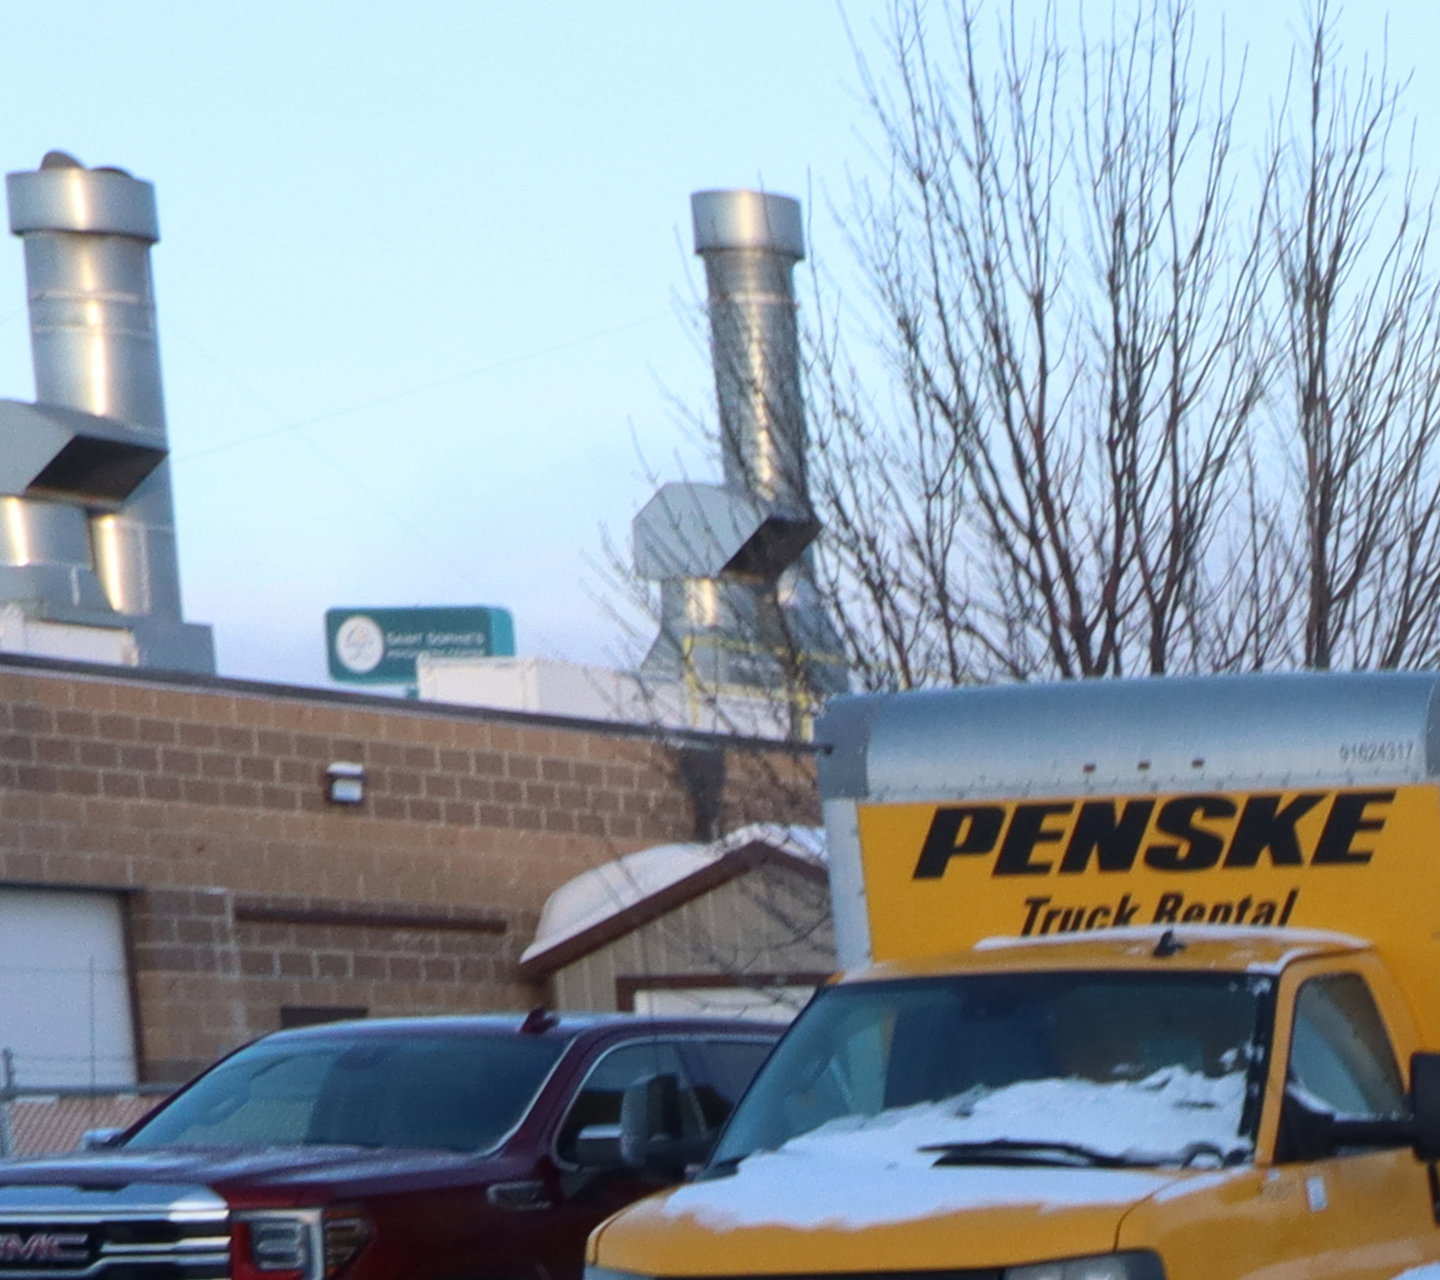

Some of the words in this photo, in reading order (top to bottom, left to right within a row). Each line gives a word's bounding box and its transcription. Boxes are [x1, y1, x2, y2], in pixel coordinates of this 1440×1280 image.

[911, 790, 1397, 879] PENSKE
[1020, 891, 1139, 936] Truck
[1150, 886, 1299, 927] Rental
[0, 1233, 88, 1260] MC
